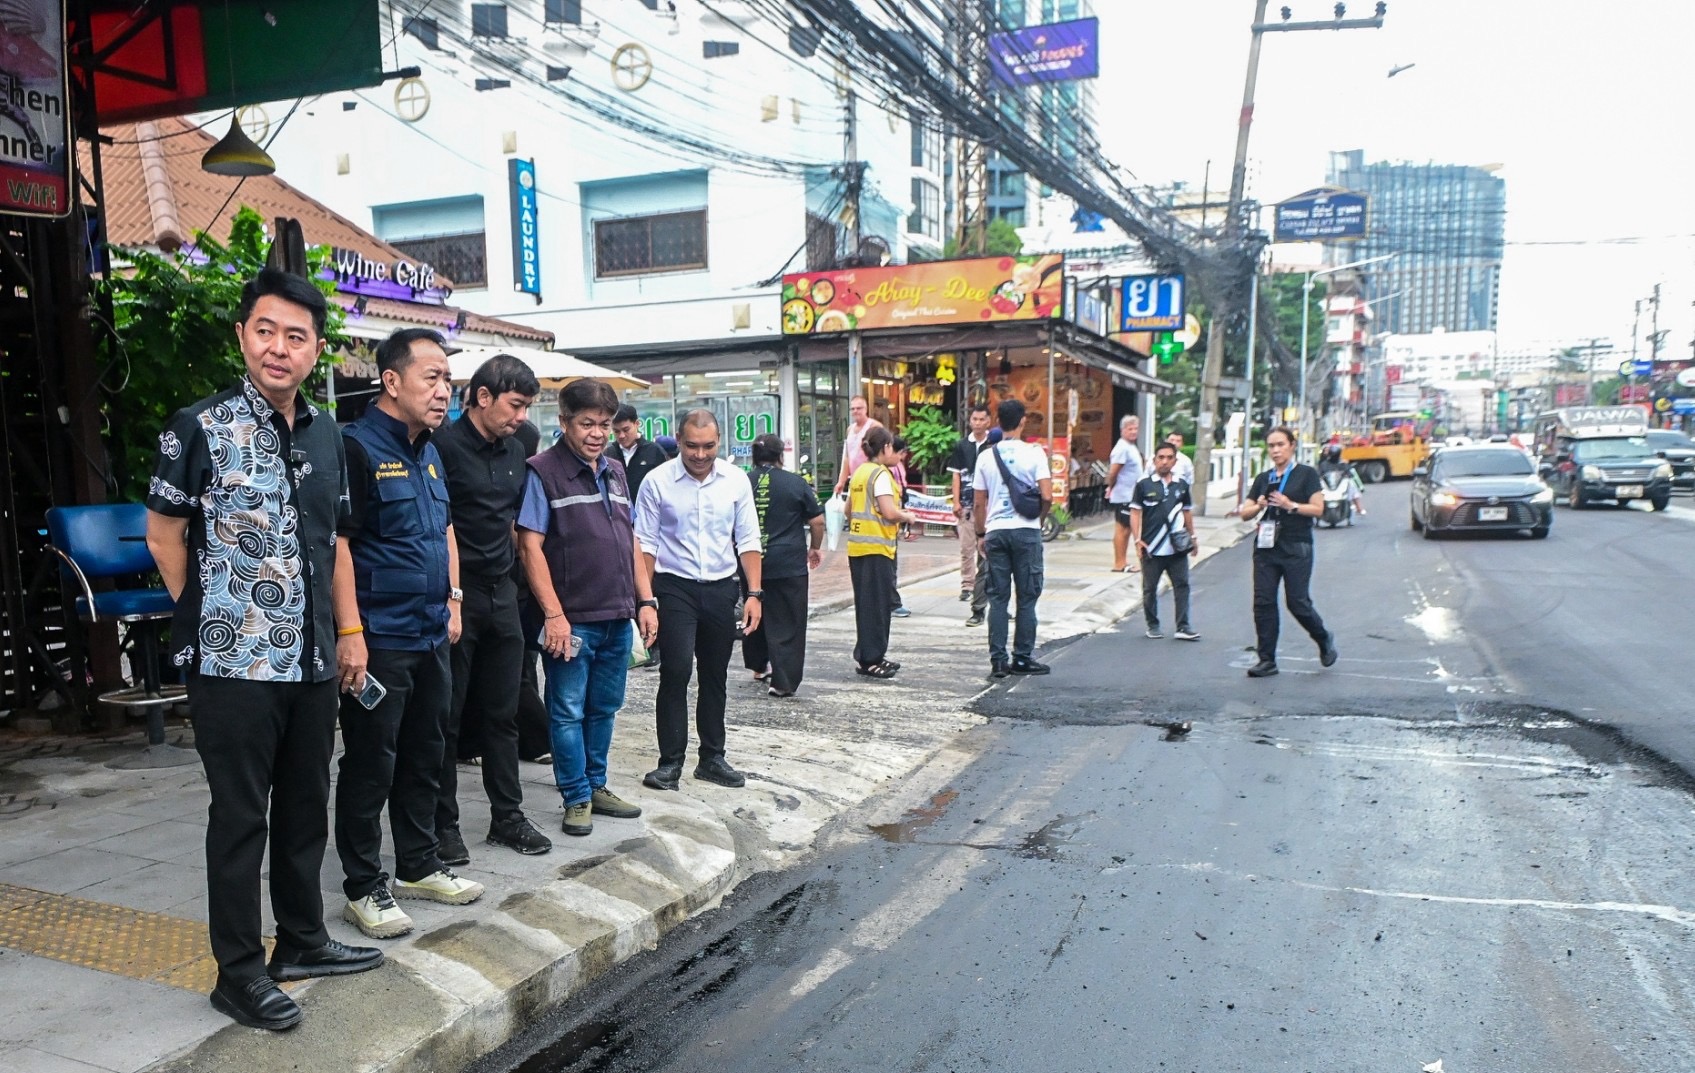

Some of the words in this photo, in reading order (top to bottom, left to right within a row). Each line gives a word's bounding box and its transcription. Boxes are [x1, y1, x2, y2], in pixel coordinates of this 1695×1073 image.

[521, 194, 536, 289] LAUNDRY
[336, 248, 386, 282] Wine
[396, 259, 435, 292] Café
[864, 276, 921, 306] Aroy
[943, 276, 987, 301] Dee
[1128, 277, 1181, 317] ยา
[1125, 315, 1181, 329] PHARMACY
